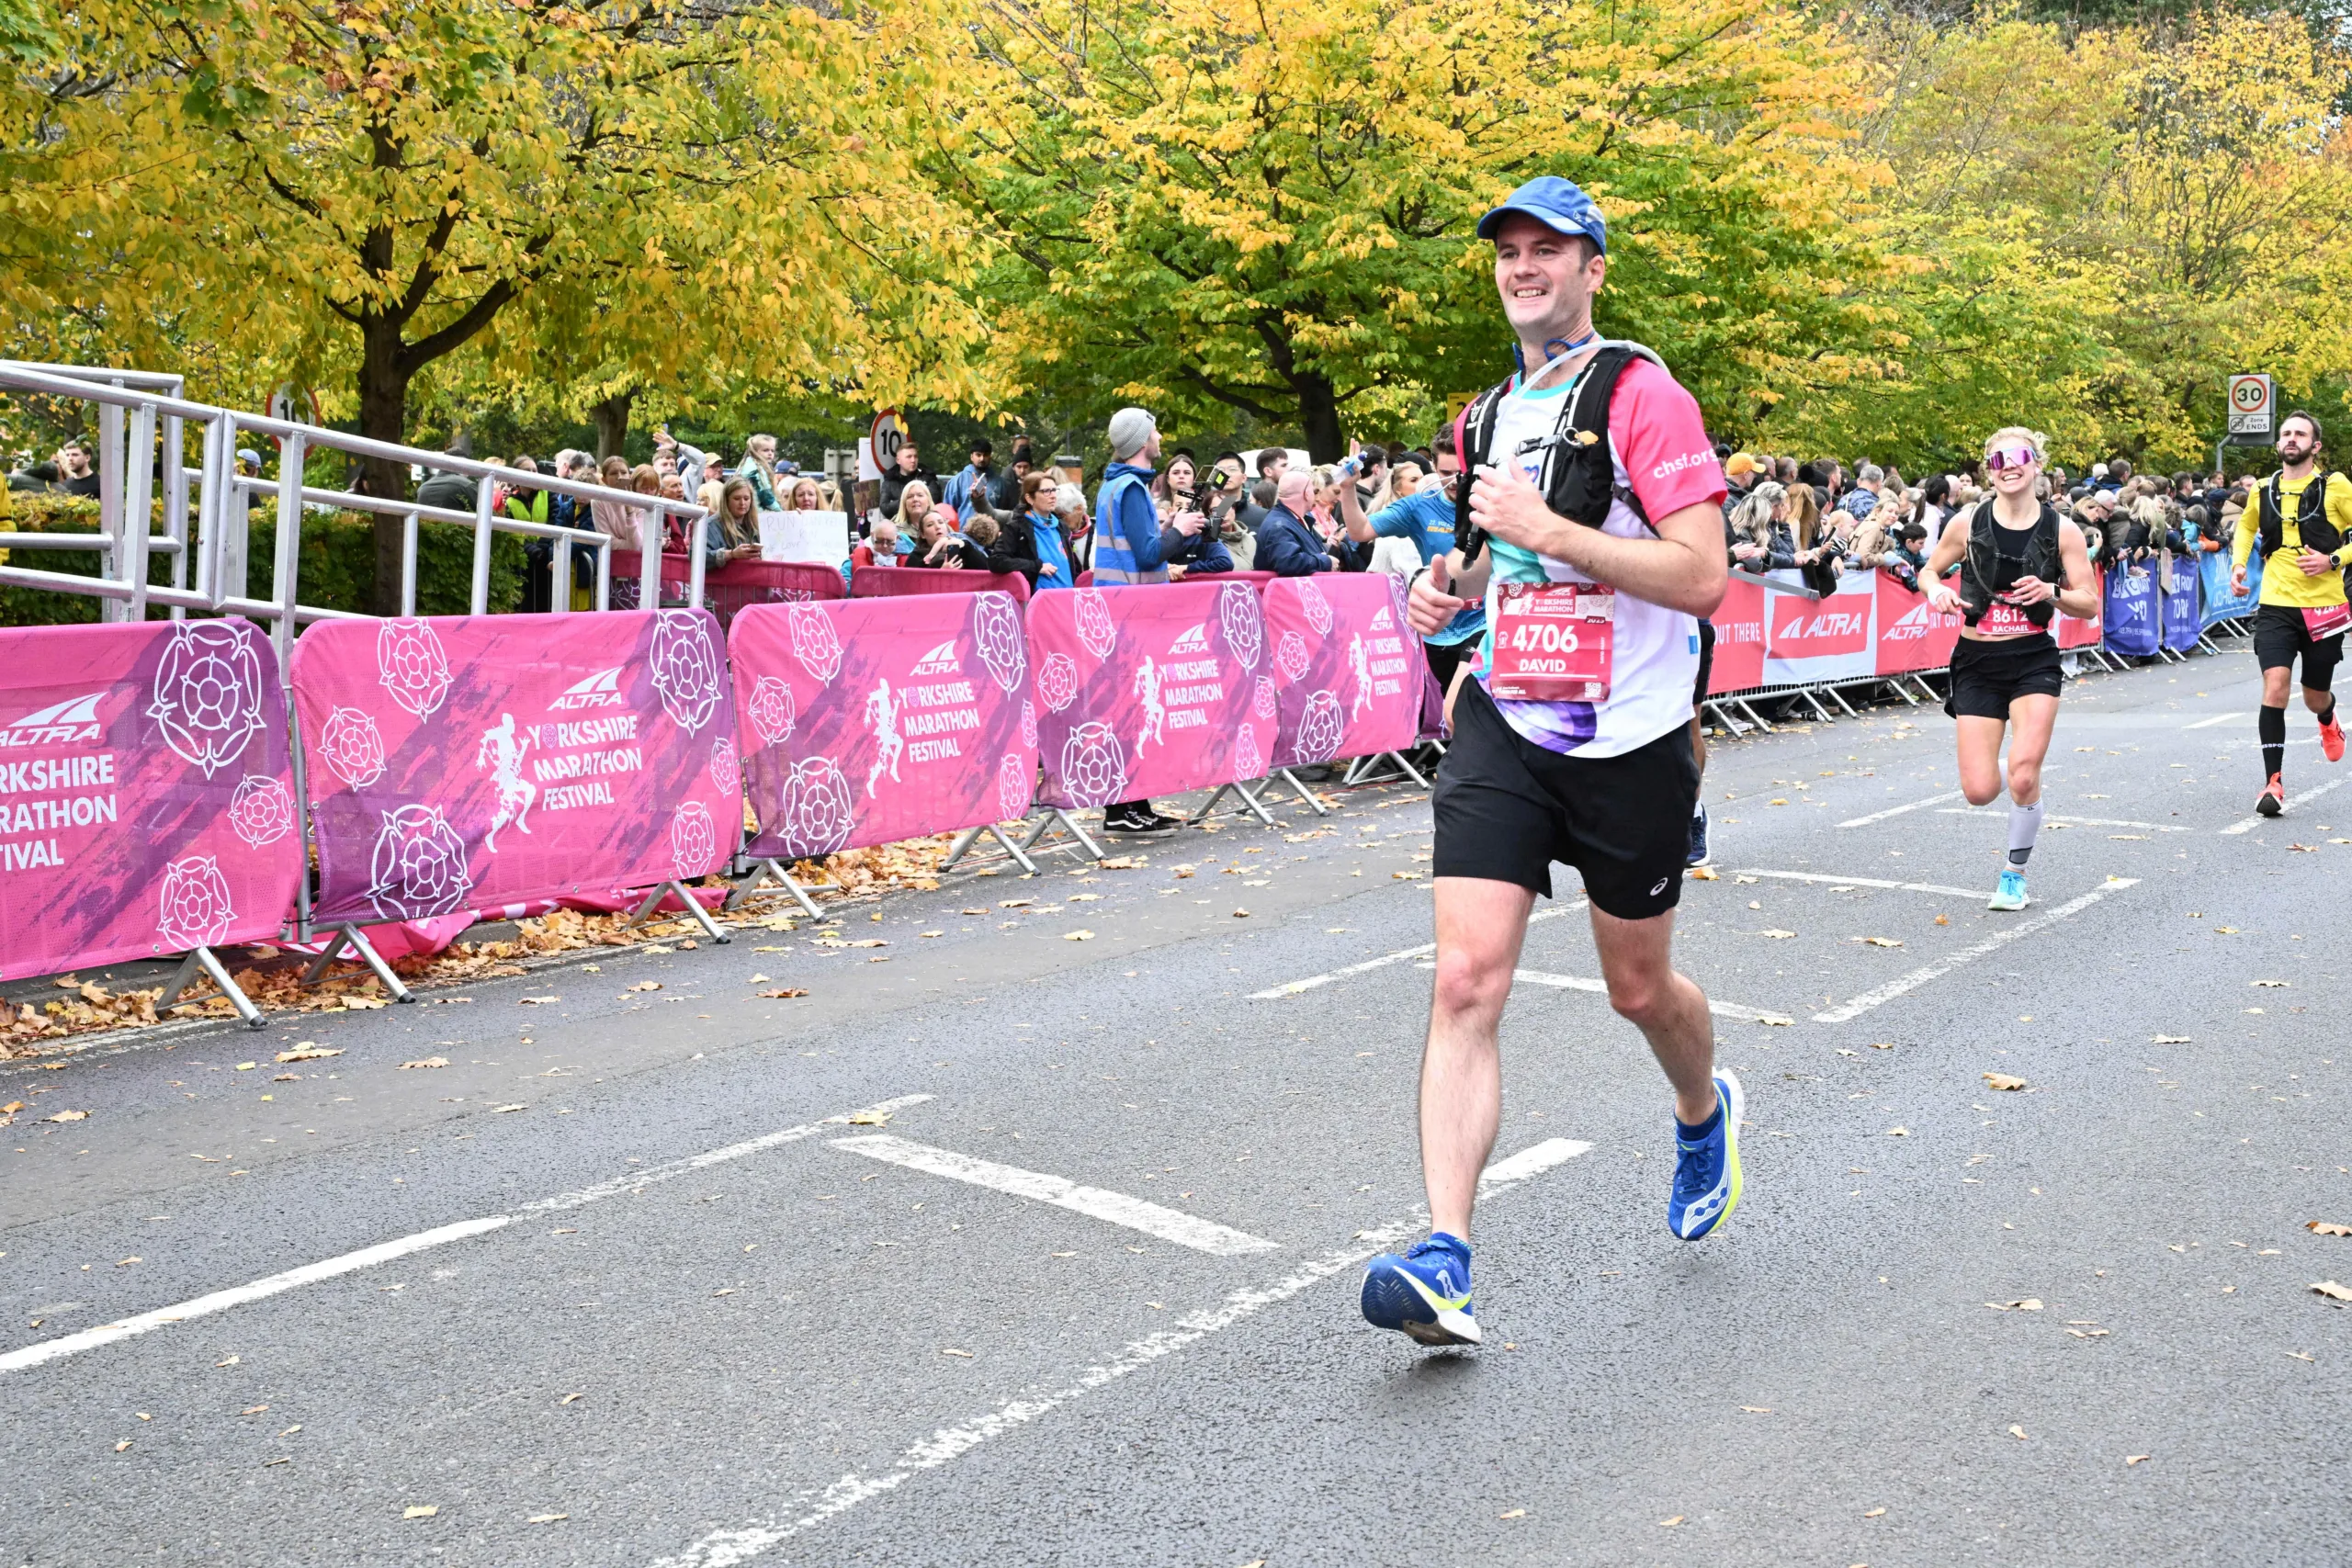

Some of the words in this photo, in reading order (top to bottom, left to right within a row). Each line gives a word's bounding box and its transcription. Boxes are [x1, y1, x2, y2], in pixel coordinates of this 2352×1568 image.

[2237, 388, 2262, 402] 30
[881, 429, 901, 457] 10
[1944, 610, 1962, 628] OUT
[1993, 608, 2029, 623] 8612
[1369, 621, 1394, 632] ALTRA
[1713, 624, 1731, 646] OUT
[1734, 622, 1761, 643] THERE
[1803, 613, 1861, 638] ALTRA
[1882, 625, 1928, 641] ALTRA
[1992, 624, 2029, 633] RACHAEL
[1512, 624, 1578, 653] 4706
[1168, 642, 1208, 655] ALTRA
[910, 660, 959, 676] ALTRA
[1371, 658, 1408, 677] MARATHON
[1519, 659, 1566, 672] DAVID
[1165, 683, 1224, 706] MARATHON
[1374, 679, 1402, 696] FESTIVAL
[546, 693, 622, 711] ALTRA
[904, 708, 980, 738] MARATHON
[1168, 708, 1208, 729] FESTIVAL
[908, 738, 961, 763] FESTIVAL
[533, 747, 642, 782] MARATHON
[542, 781, 615, 811] FESTIVAL
